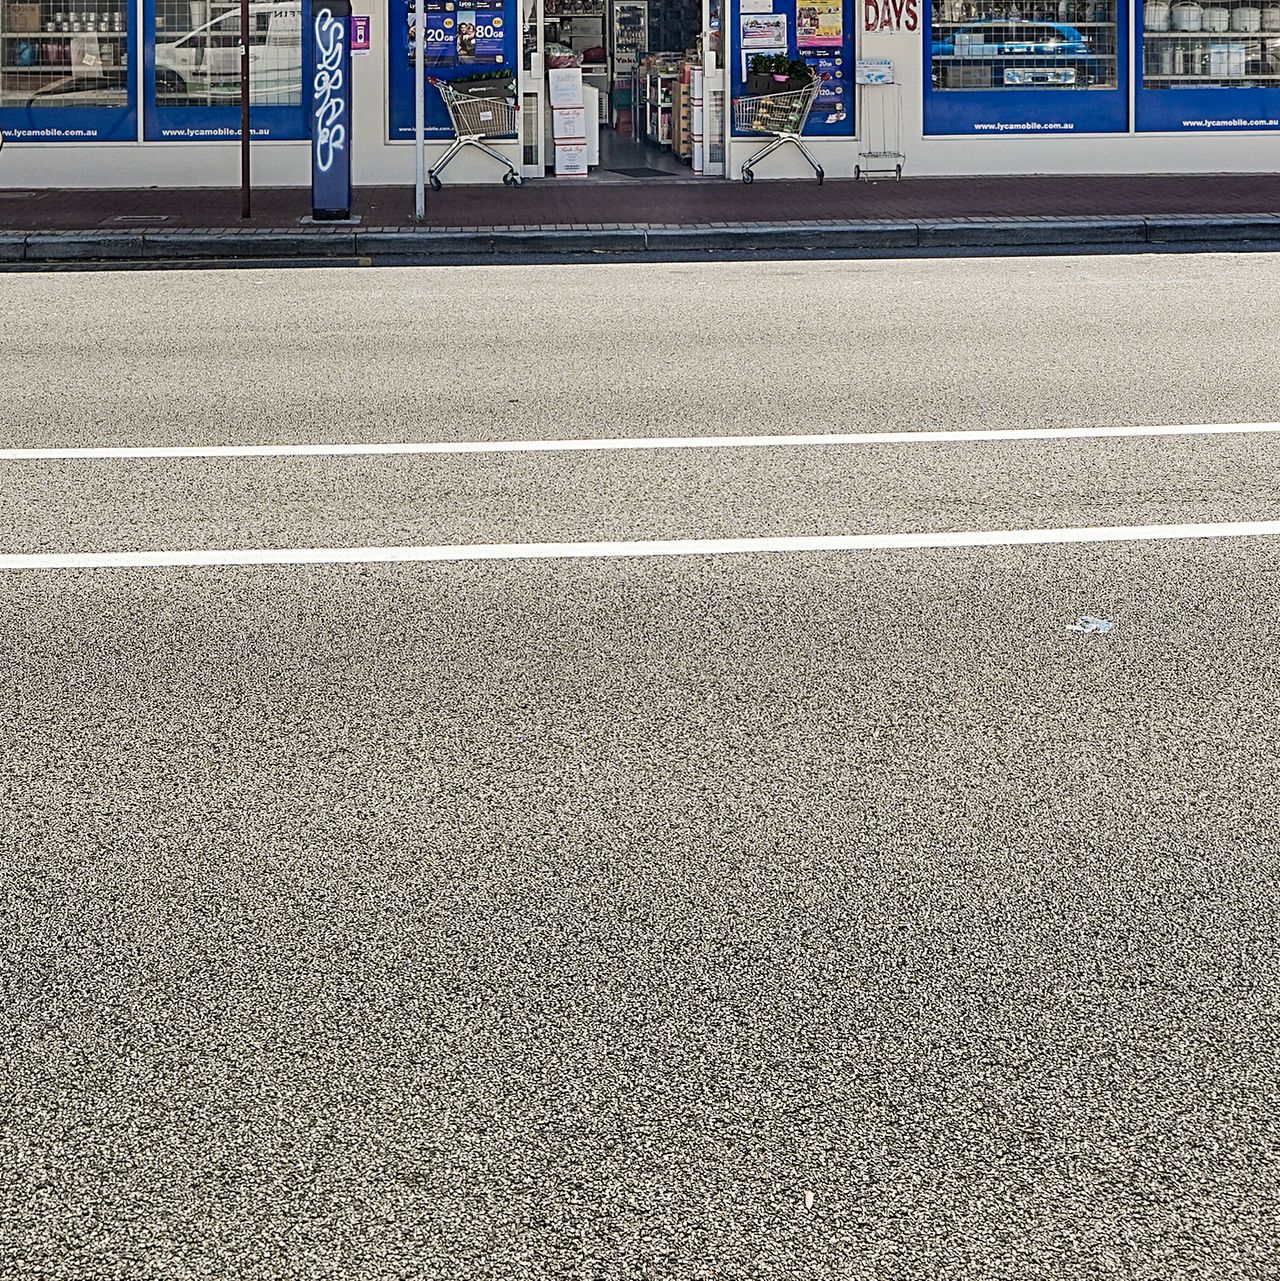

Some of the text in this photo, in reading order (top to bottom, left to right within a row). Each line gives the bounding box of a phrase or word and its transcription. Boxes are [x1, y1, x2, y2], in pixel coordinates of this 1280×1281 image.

[974, 122, 1074, 131] www.lycamobile.com.au
[1182, 118, 1279, 127] www.lycamobile.com.au
[162, 128, 270, 137] www.lycamobile.cm.au
